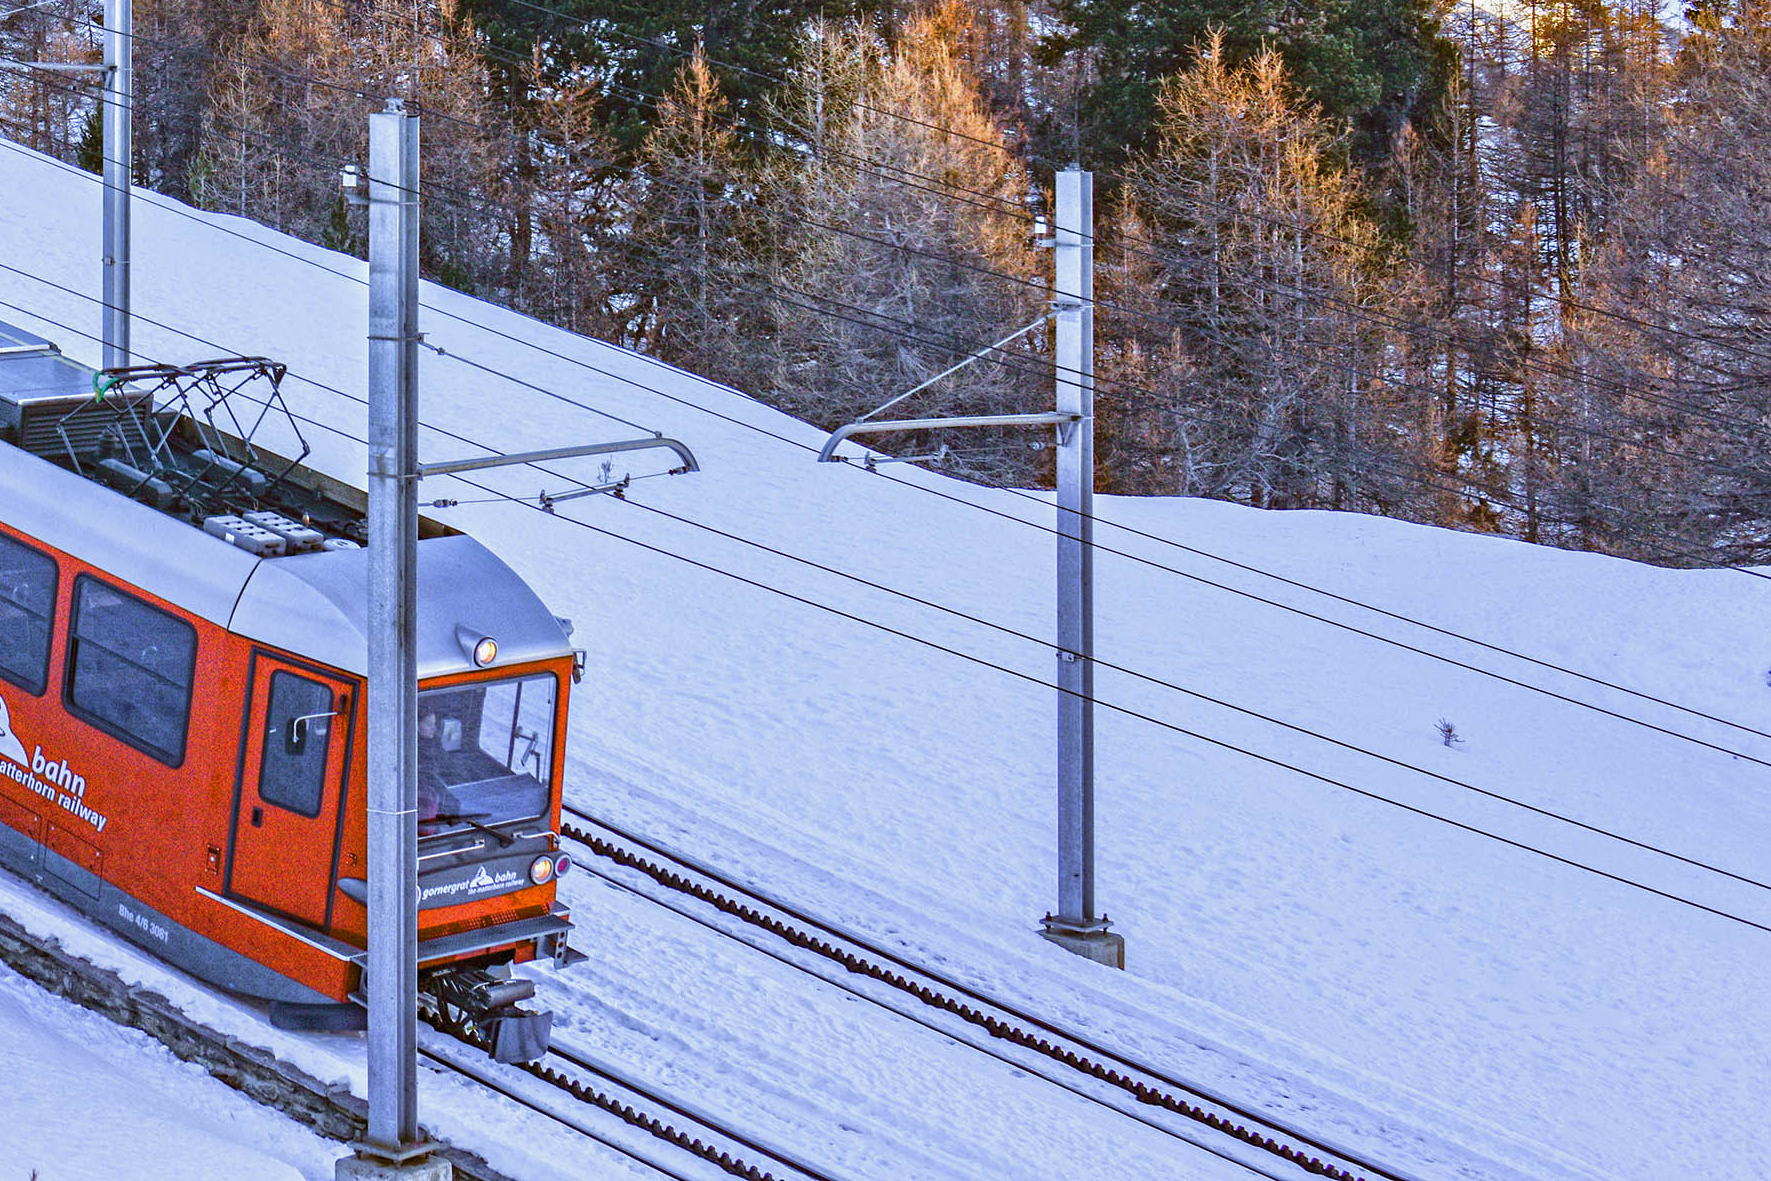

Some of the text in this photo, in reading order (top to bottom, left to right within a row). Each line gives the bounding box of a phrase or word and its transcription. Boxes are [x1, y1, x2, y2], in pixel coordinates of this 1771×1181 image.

[32, 746, 86, 797] bahn
[57, 792, 107, 832] railway
[422, 871, 516, 900] gornergrat bahn
[119, 904, 168, 943] Bhe 4/6 3081
